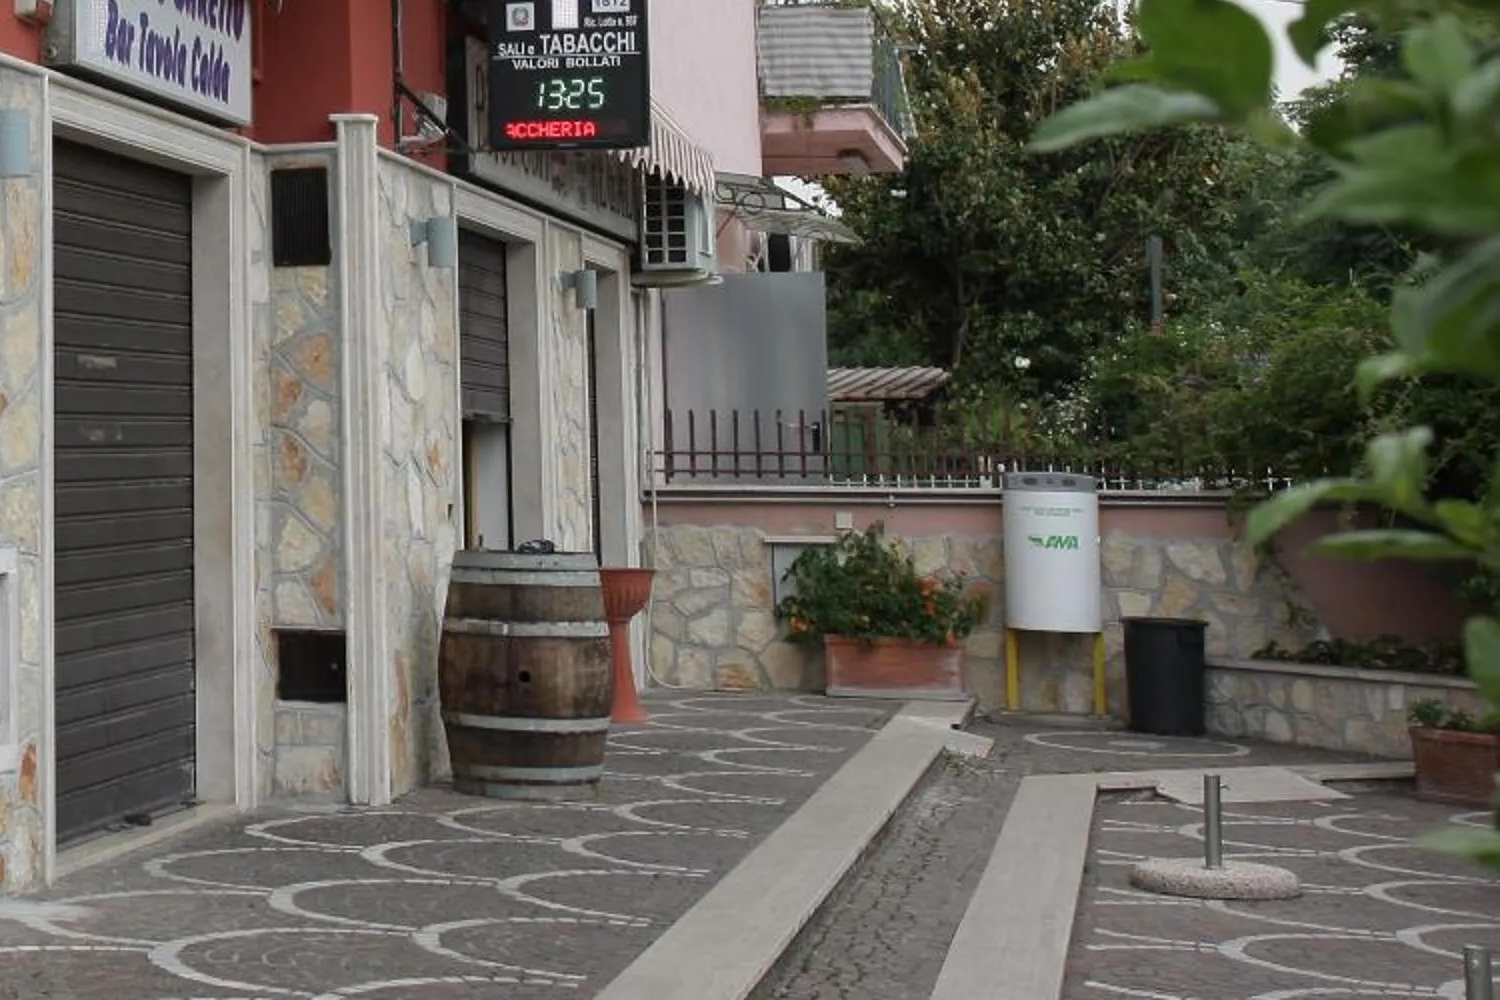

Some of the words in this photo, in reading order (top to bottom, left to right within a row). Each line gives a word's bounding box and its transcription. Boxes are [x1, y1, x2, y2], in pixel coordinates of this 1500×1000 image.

[497, 42, 525, 57] SALI
[539, 31, 635, 55] TABACCHI
[511, 57, 559, 70] VALORI
[565, 55, 621, 69] BOLLATI
[538, 78, 604, 109] 13:25
